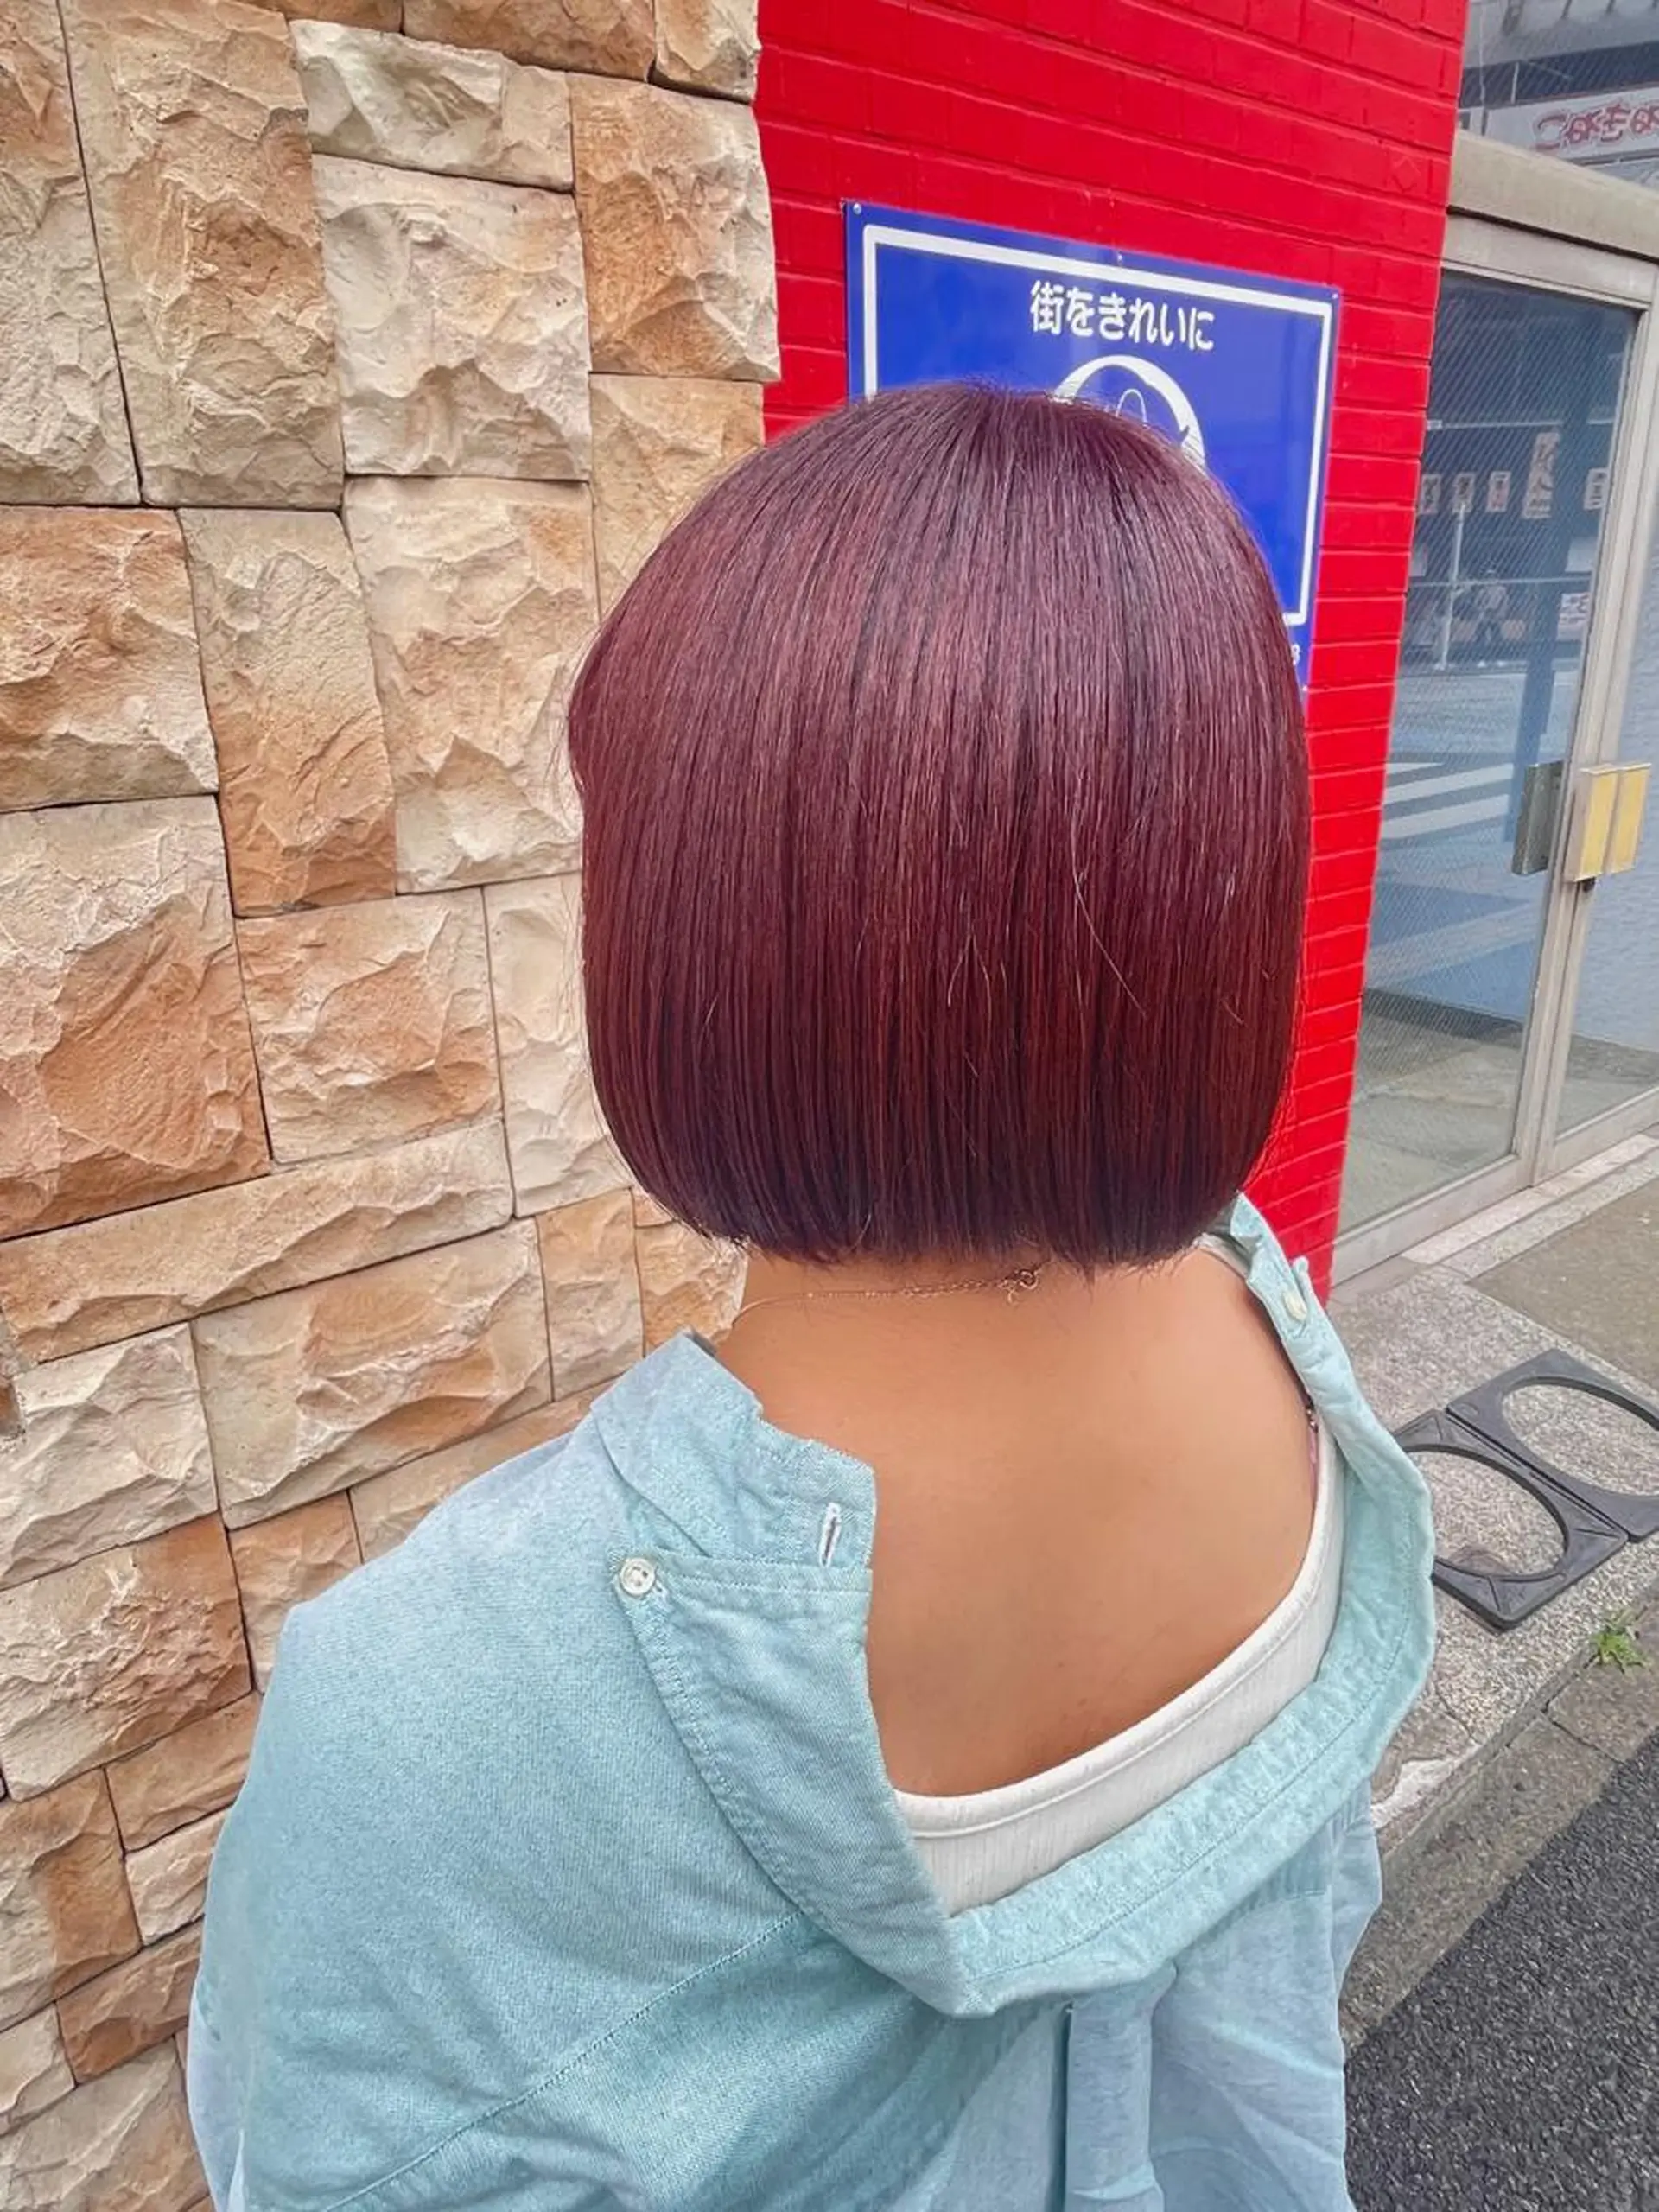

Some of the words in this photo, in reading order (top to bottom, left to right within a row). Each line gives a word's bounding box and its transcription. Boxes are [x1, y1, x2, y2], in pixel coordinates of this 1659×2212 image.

[1030, 280, 1214, 350] 街をきれいに
